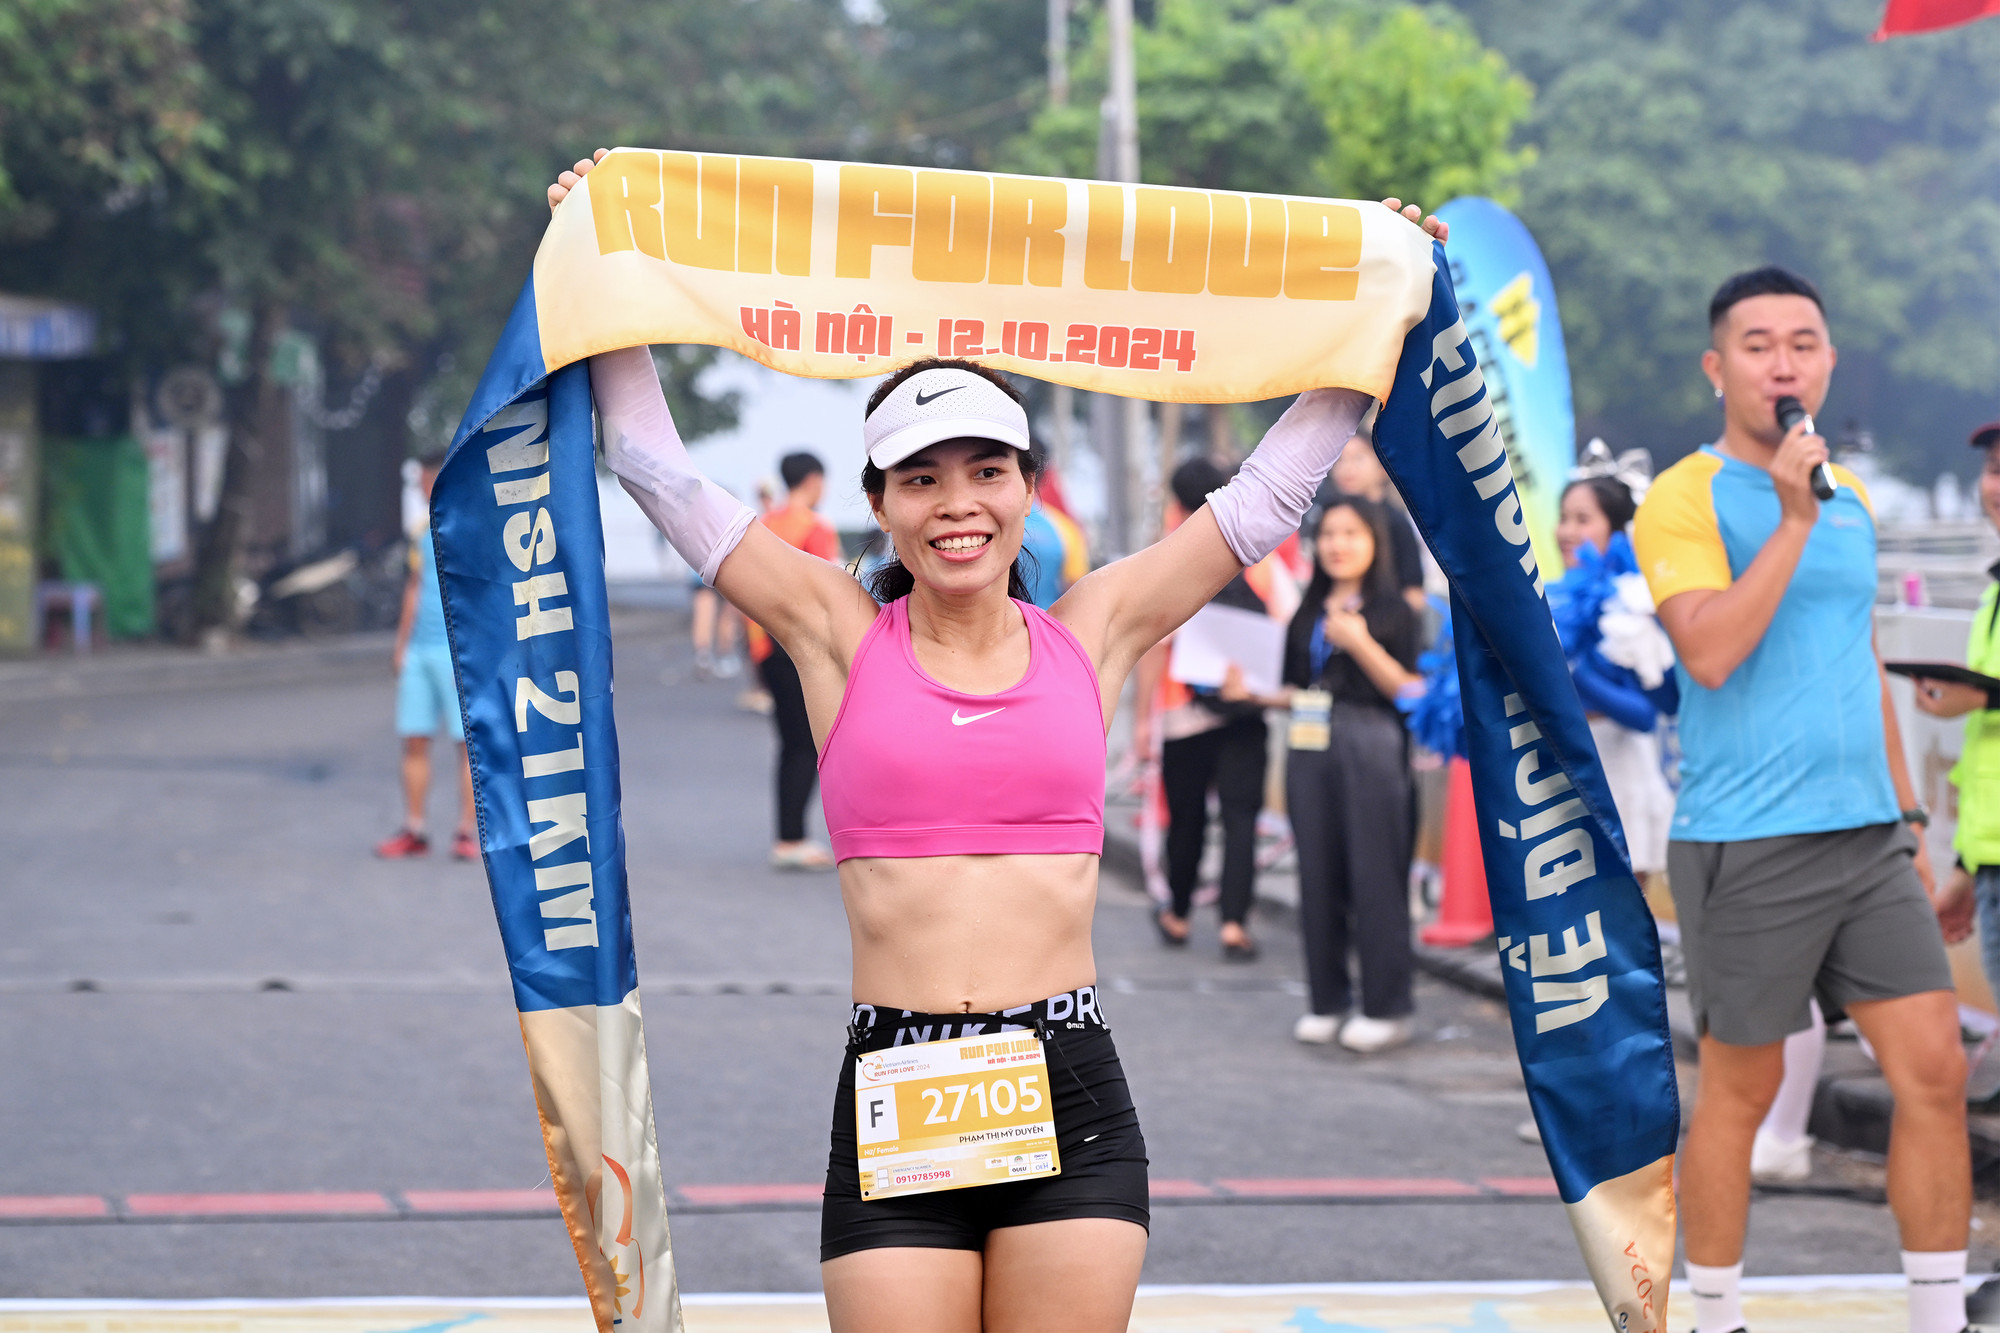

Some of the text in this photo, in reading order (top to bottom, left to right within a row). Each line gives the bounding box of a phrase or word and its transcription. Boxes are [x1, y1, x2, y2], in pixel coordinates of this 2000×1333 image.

[591, 151, 1362, 301] RUN FOR LOVE
[739, 299, 802, 352] HÀ
[937, 318, 1197, 372] 12.10.2024
[482, 376, 575, 642] NISH
[1498, 910, 1609, 1034] VỀ
[959, 1045, 985, 1060] RUN
[986, 1042, 1010, 1056] FOR
[869, 1100, 884, 1128] F
[921, 1074, 1042, 1126] 27105
[877, 1146, 899, 1154] Female
[959, 1133, 985, 1144] PHẠM
[985, 1131, 1000, 1141] THỊ
[1015, 1124, 1044, 1137] DUYÊN
[896, 1170, 951, 1184] 0919785998
